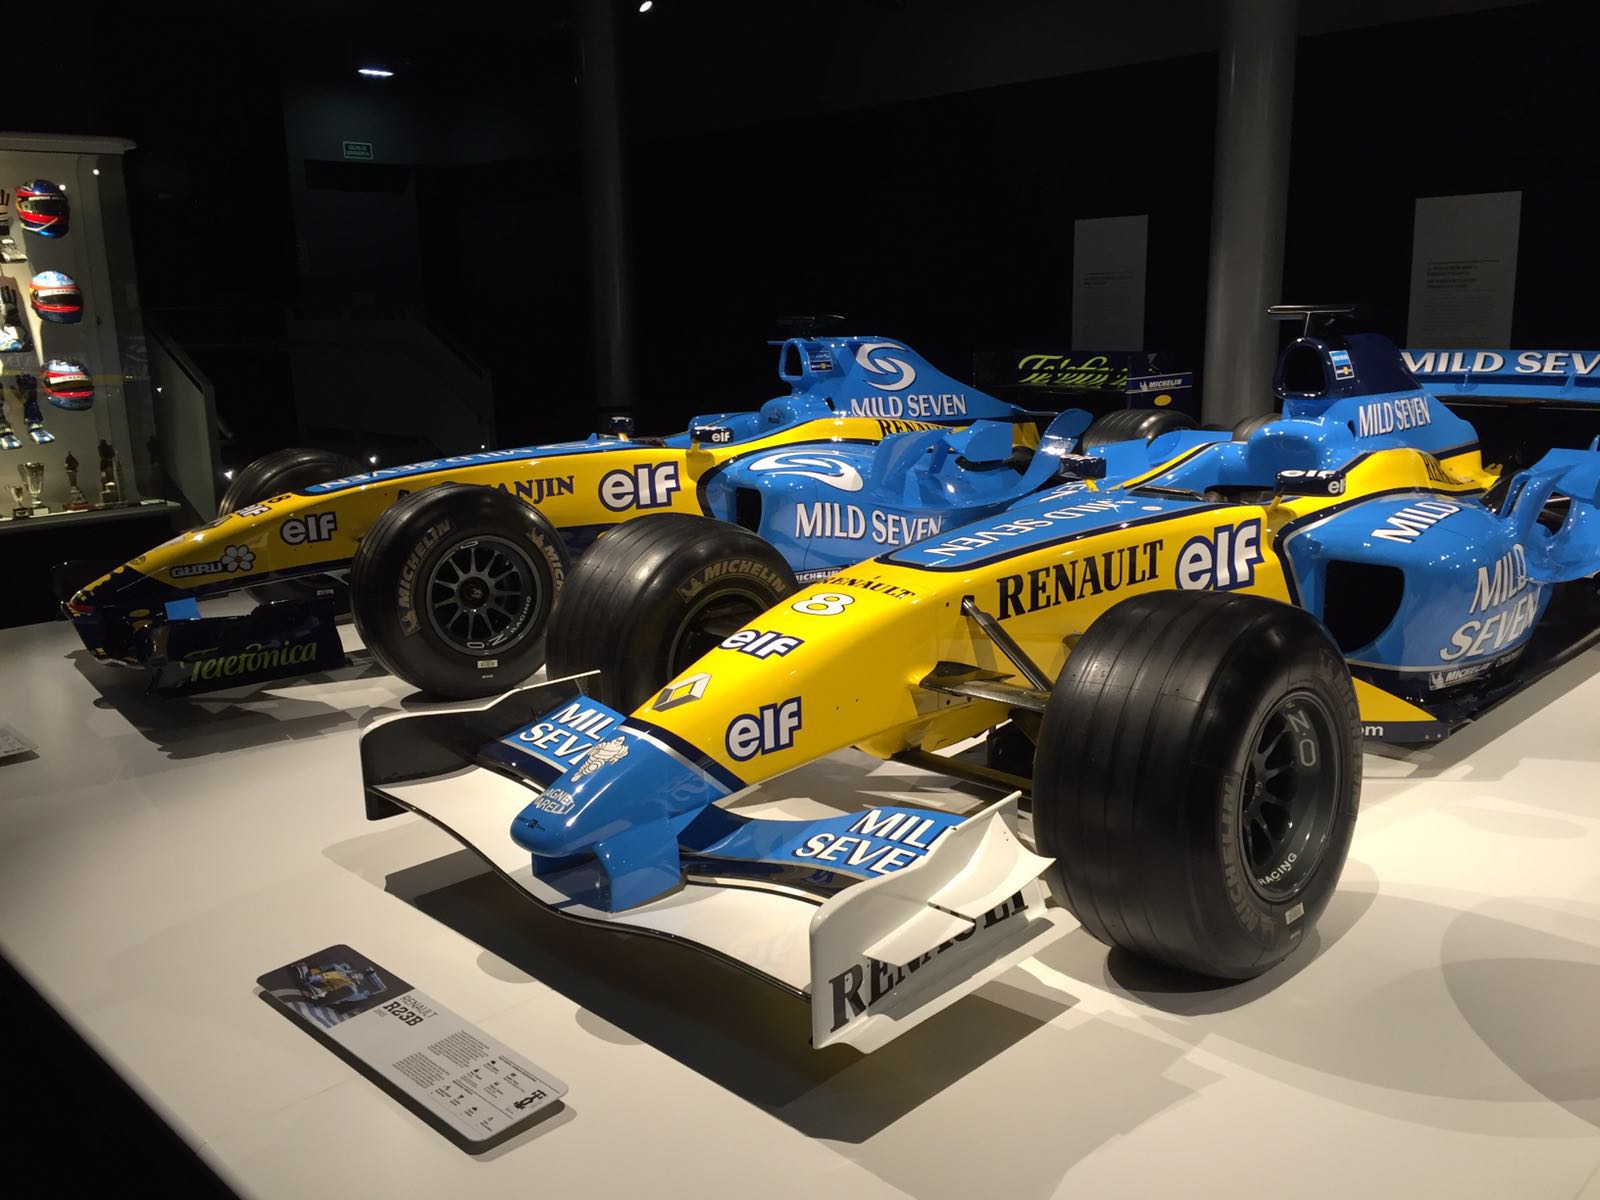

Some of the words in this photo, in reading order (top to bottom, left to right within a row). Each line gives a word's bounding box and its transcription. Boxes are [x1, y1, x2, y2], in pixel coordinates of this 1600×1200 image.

[1402, 352, 1504, 373] MILD
[1149, 378, 1183, 389] MICHELIN
[850, 395, 904, 418] MILD
[907, 394, 968, 418] SEVEN
[1359, 402, 1395, 438] MILD
[1394, 396, 1432, 431] SEVEN
[711, 431, 731, 442] elf
[600, 461, 679, 511] elf
[281, 512, 337, 545] elf
[795, 502, 867, 539] MILD
[923, 517, 1054, 557] SEVEN
[1370, 502, 1462, 544] MILD
[171, 562, 222, 578] GURU
[1176, 518, 1264, 592] elf
[703, 559, 787, 594] MICHELIN
[996, 539, 1164, 621] RENAULT
[1469, 543, 1529, 615] MILD
[791, 592, 856, 617] 8
[1439, 585, 1543, 661] SEVEN
[718, 629, 804, 660] elf
[726, 696, 802, 762] elf
[1257, 852, 1298, 886] RACING
[382, 1001, 424, 1027] R23B
